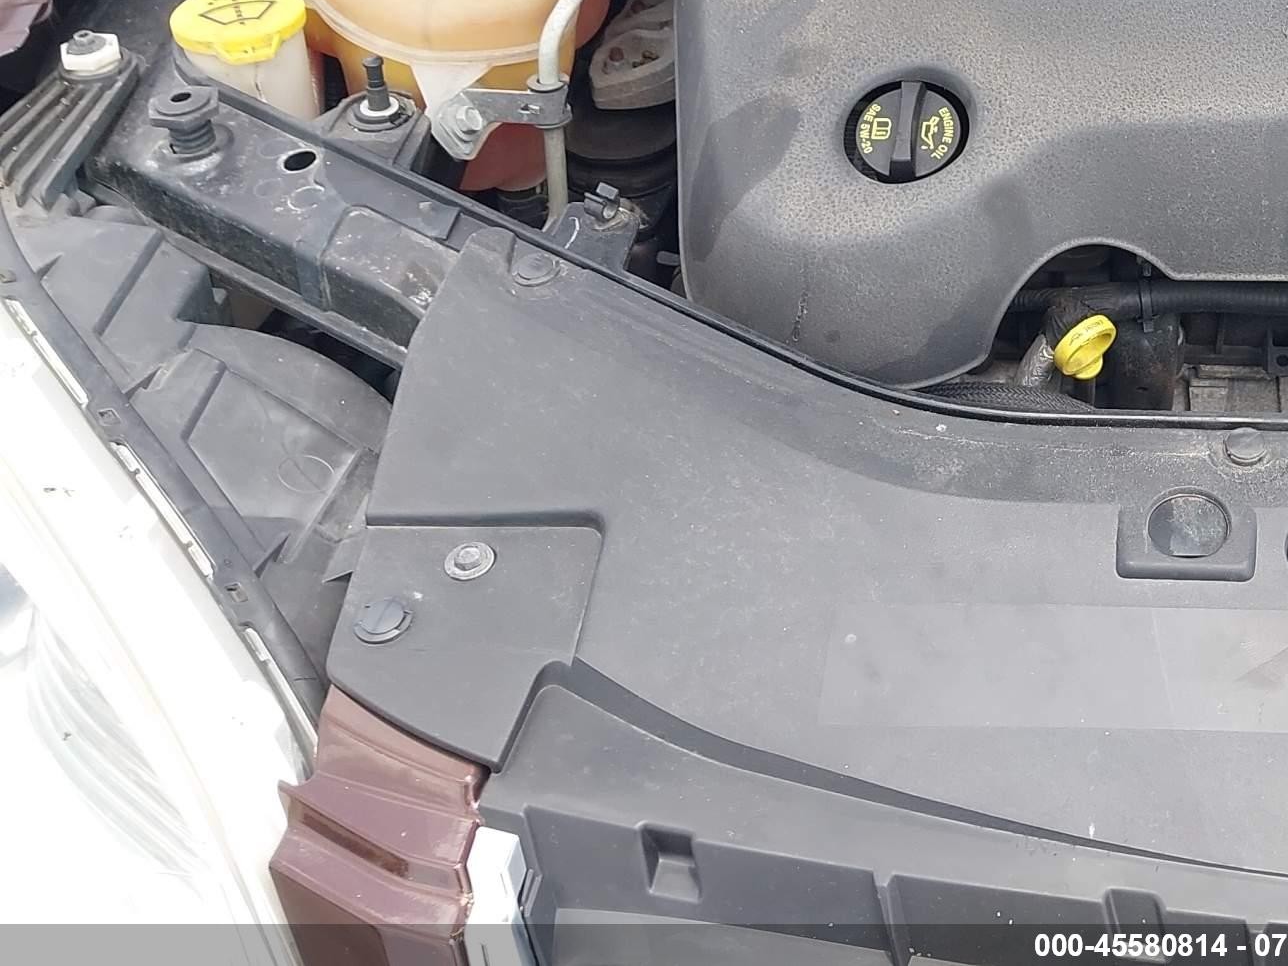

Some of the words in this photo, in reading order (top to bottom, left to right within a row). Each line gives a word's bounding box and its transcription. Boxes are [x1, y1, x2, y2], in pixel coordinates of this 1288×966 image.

[864, 104, 881, 123] SAE
[938, 107, 954, 143] ENGINE
[860, 123, 873, 154] 5W-20
[930, 144, 948, 159] OIL
